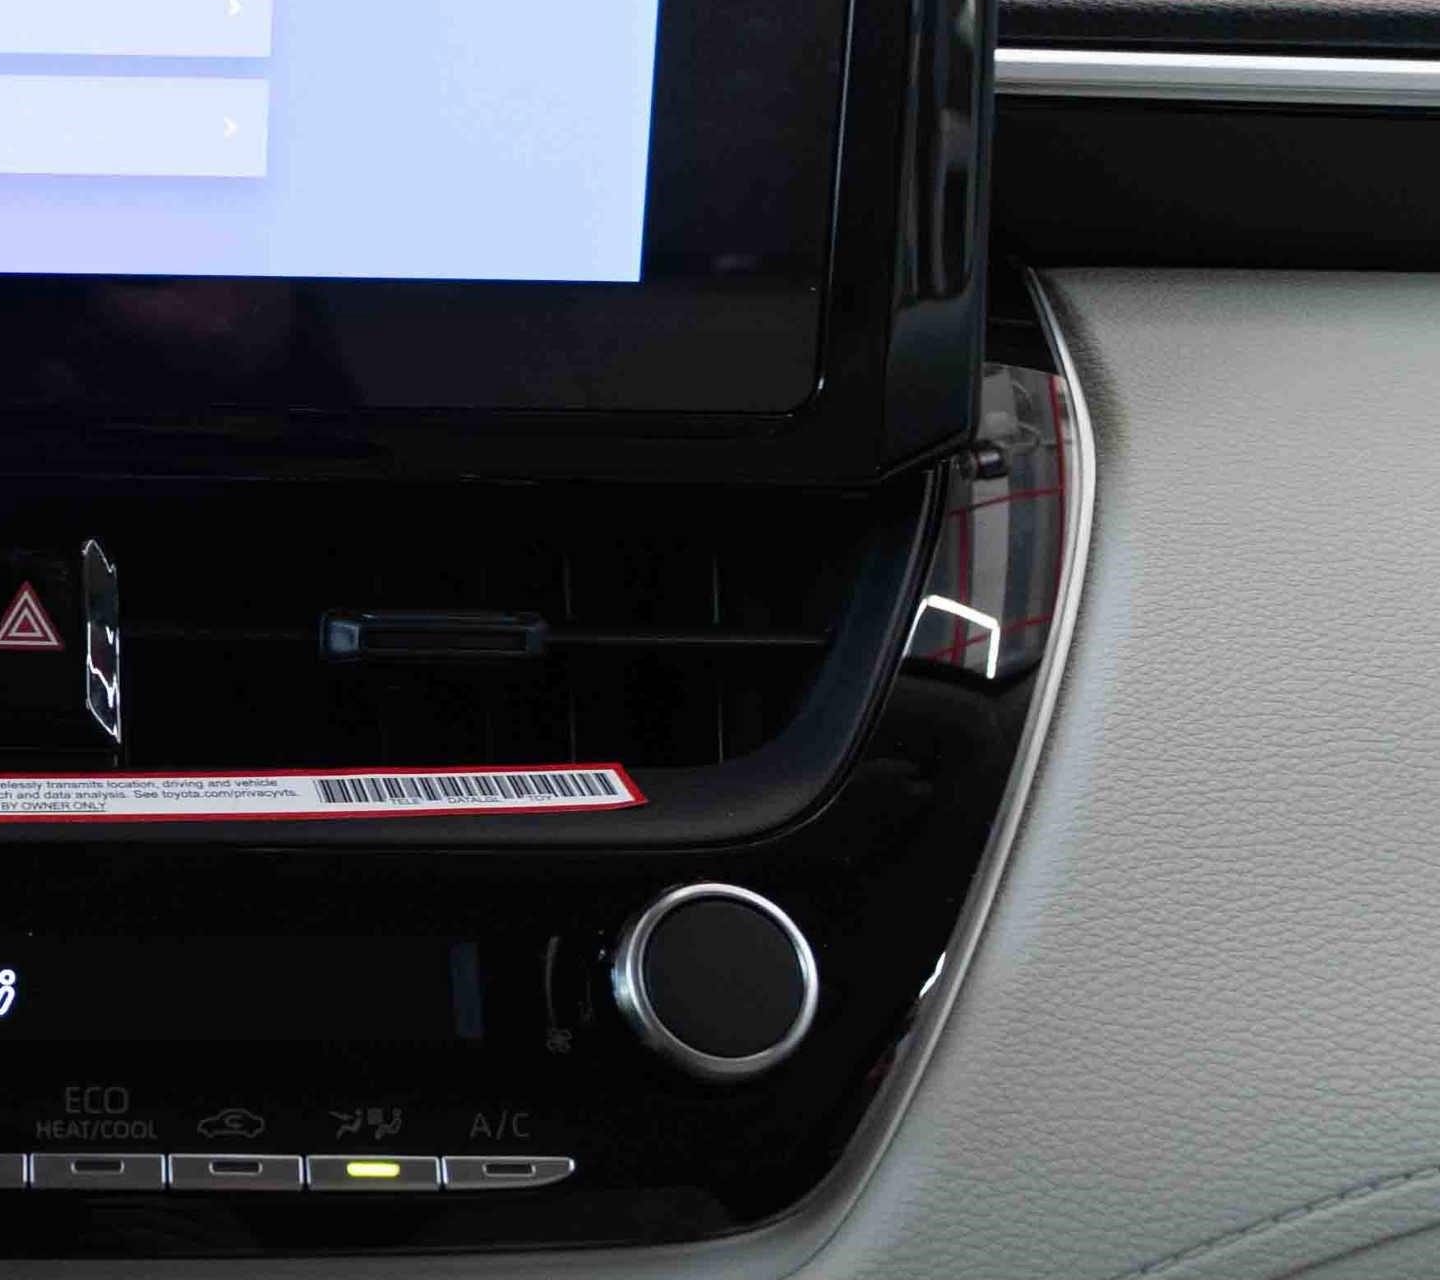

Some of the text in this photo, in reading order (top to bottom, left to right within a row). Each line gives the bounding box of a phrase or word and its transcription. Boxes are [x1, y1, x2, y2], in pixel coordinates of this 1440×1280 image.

[64, 1085, 129, 1115] ECO
[36, 1119, 158, 1140] HEAT/COOL
[469, 1110, 530, 1140] A/C
